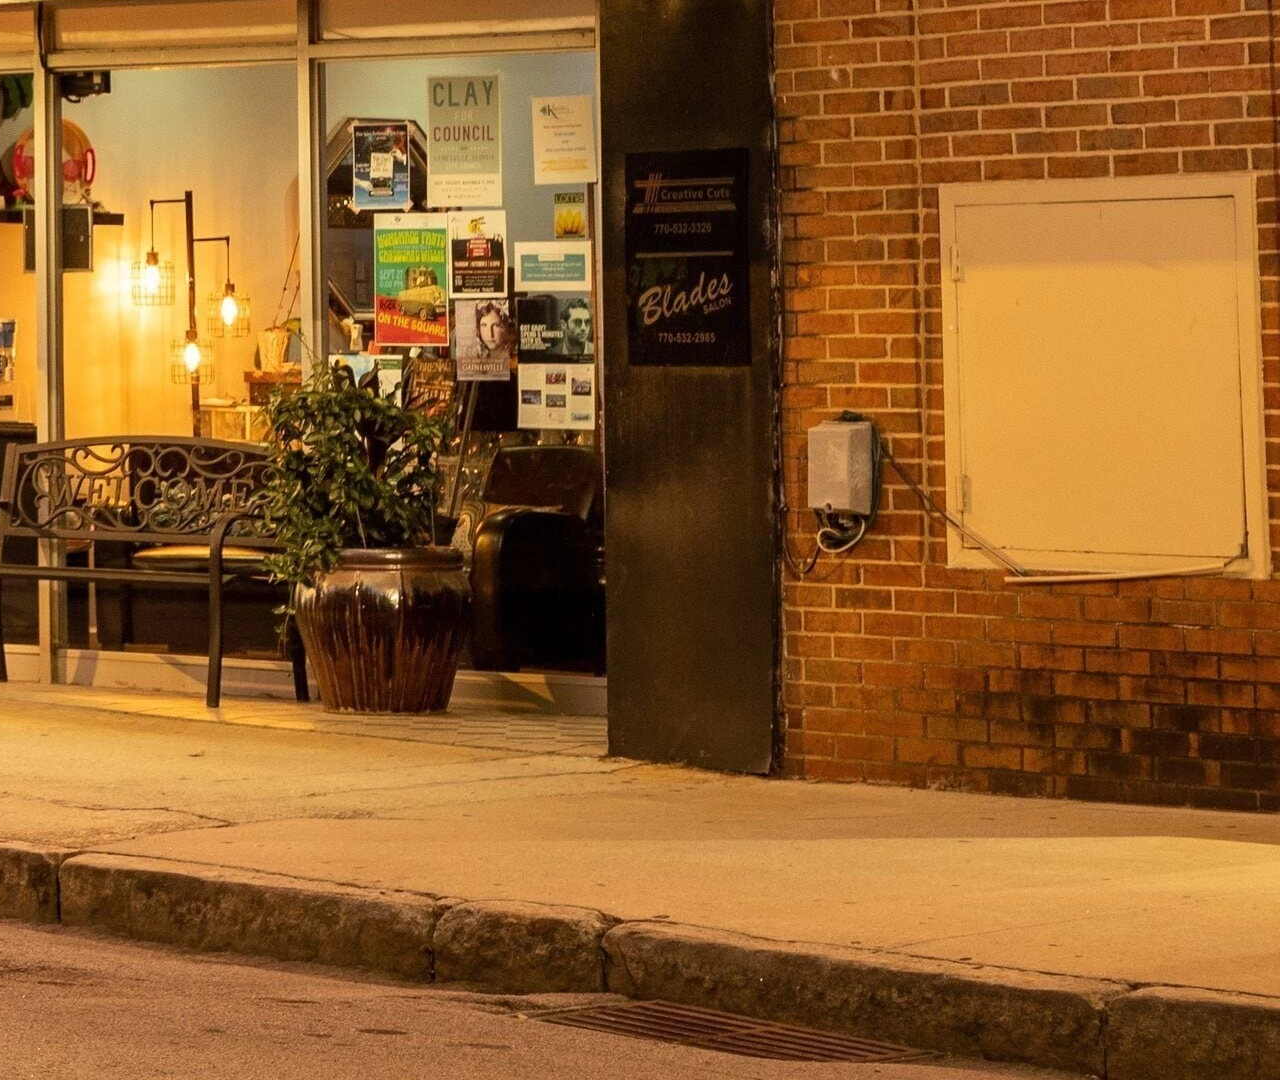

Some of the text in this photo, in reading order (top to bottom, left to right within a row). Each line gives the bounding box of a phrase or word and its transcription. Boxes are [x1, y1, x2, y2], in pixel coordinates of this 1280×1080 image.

[432, 80, 493, 107] CLAY
[454, 111, 474, 121] FOR
[433, 125, 495, 142] COUNCIL
[660, 187, 730, 200] Creative Cuts
[638, 271, 733, 325] Blades
[703, 296, 732, 314] SALON
[377, 313, 446, 337] ON THE SQUARE
[542, 330, 563, 338] MINUTES
[462, 363, 503, 371] GAINESVILLE
[46, 472, 255, 513] WELCOME
